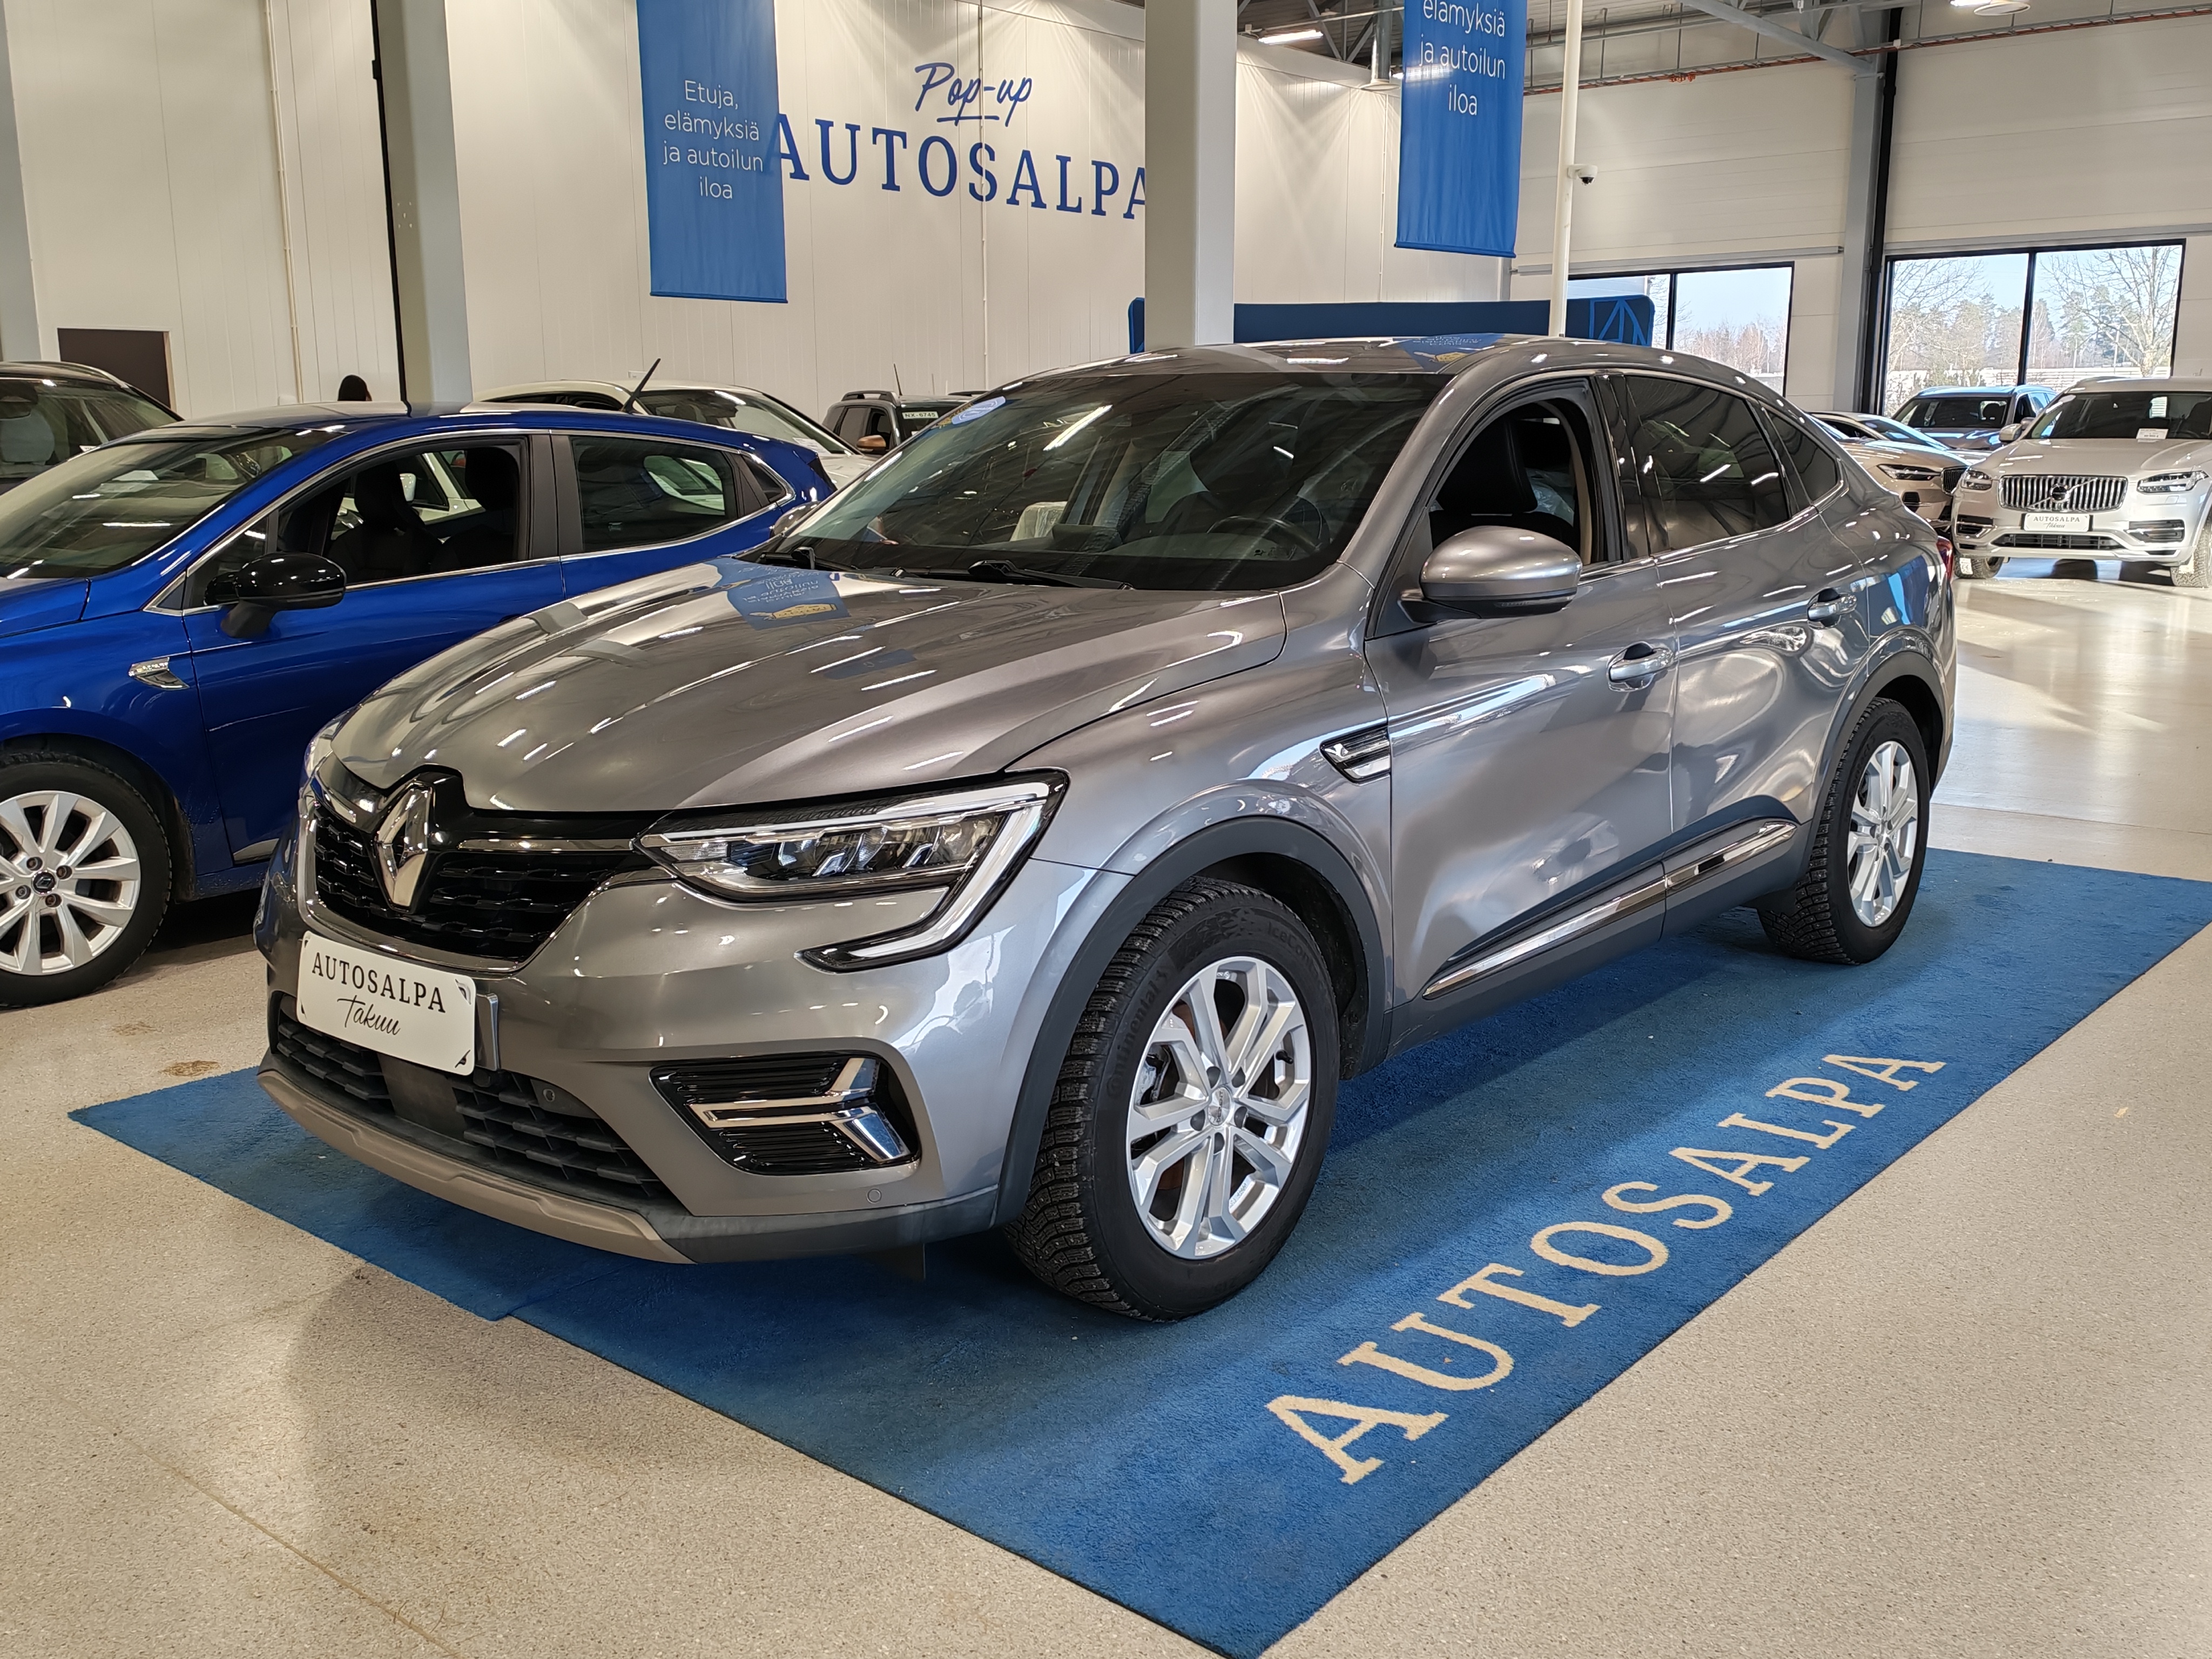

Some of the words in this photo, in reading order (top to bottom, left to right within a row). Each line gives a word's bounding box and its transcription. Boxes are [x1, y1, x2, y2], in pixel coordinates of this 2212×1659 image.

[1419, 33, 1434, 67] ja
[1440, 44, 1505, 80] autoilun
[685, 80, 738, 110] Etuja,
[914, 62, 1032, 127] Pop-up
[1448, 84, 1478, 116] iloa
[665, 110, 759, 141] elämyksiä
[663, 140, 680, 165] ja
[687, 147, 763, 172] autoilun
[765, 113, 1145, 219] AUTOSALPA
[700, 176, 732, 199] iloa
[312, 952, 446, 1014] AUTOSALPA
[337, 995, 401, 1036] Takuu
[1265, 1054, 1946, 1485] AUTOSALPA
